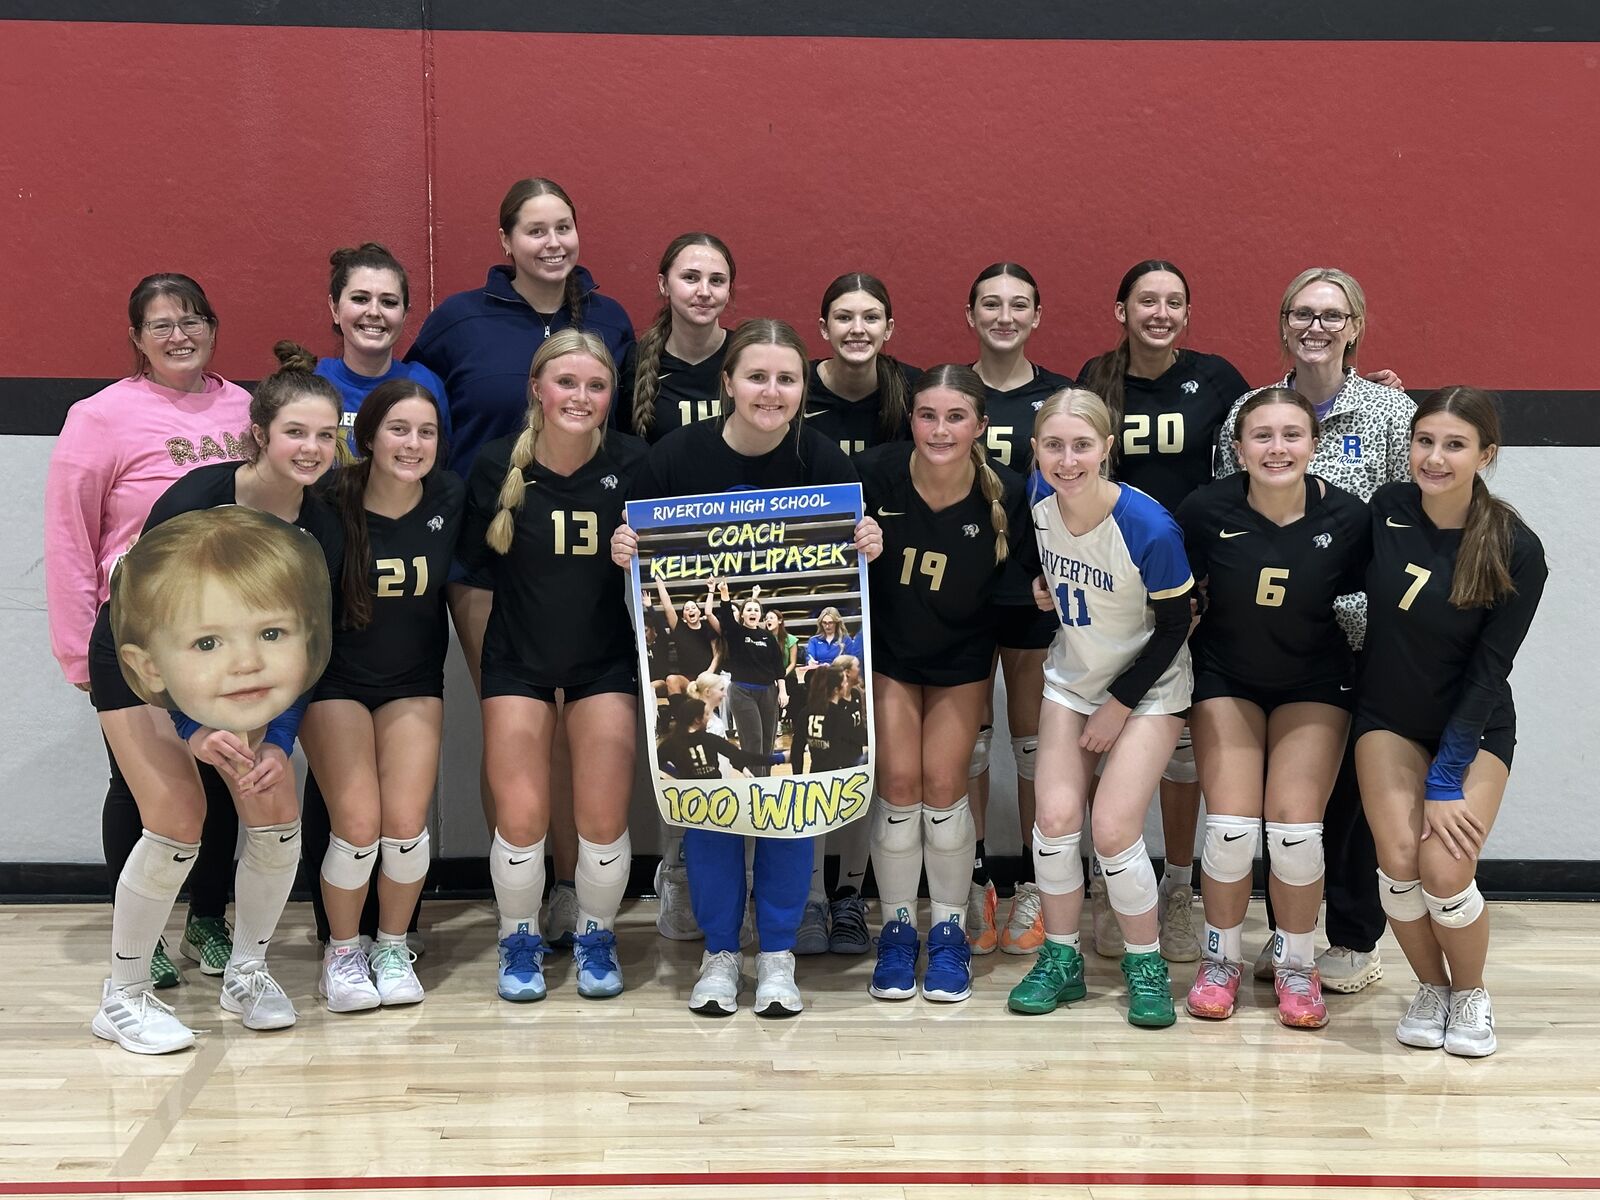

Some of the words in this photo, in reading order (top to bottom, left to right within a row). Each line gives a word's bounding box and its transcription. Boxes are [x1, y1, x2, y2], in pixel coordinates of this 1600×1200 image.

[1123, 412, 1185, 455] 20
[1343, 435, 1362, 458] R
[653, 501, 724, 520] RIVERTON
[730, 499, 765, 514] HIGH
[770, 494, 830, 511] SCHOOL
[551, 510, 599, 555] 13
[707, 522, 786, 547] COACH
[375, 555, 429, 597] 21
[650, 552, 743, 580] KELLYN
[751, 542, 849, 573] LIPASEK
[900, 547, 948, 591] 19
[1055, 583, 1092, 627] 11
[1255, 567, 1290, 607] 6
[1398, 562, 1433, 611] 7
[808, 715, 825, 738] 15
[662, 786, 739, 827] 100
[749, 772, 869, 832] WINS
